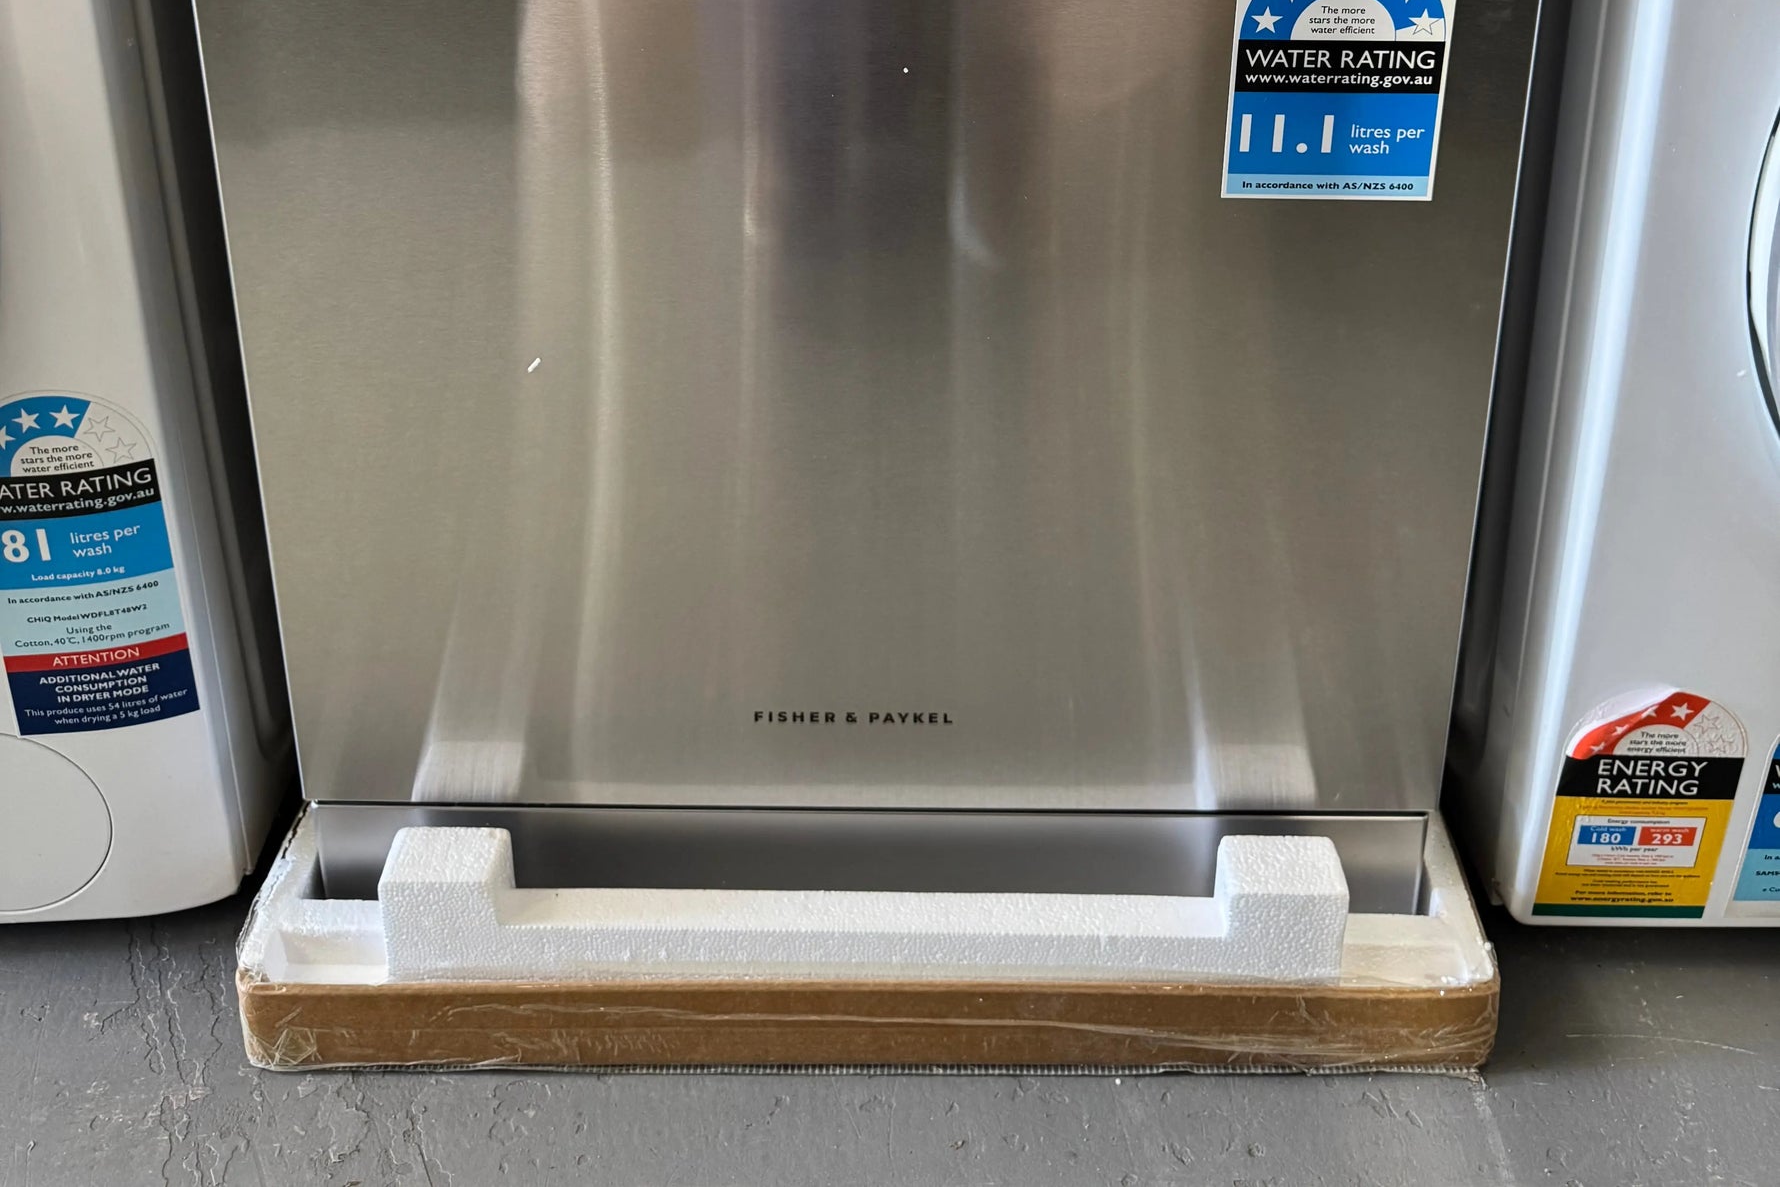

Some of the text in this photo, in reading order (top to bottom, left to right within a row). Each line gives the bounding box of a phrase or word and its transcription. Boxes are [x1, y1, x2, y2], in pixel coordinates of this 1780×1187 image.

[1321, 6, 1338, 14] The
[1334, 16, 1348, 24] the
[1340, 26, 1375, 35] efficient
[1246, 49, 1435, 69] WATER RATING
[1246, 73, 1433, 88] www.waterrating.gov.au
[1239, 114, 1335, 153] 11.1
[1351, 124, 1425, 142] litres per
[1349, 141, 1389, 154] wash
[1242, 181, 1253, 189] In
[1316, 181, 1339, 189] with
[1343, 182, 1386, 191] AS/NZS
[1389, 182, 1413, 191] 6400
[52, 445, 79, 453] more
[21, 452, 92, 464] stars the more
[23, 460, 94, 473] water efficient
[0, 467, 152, 500] ATER RATING
[0, 487, 154, 514] w.waterrating.gov.au
[70, 525, 141, 544] litres per
[73, 543, 112, 558] wash
[31, 566, 125, 581] Load capacity 8.0 kg
[19, 595, 71, 604] accordance
[74, 591, 95, 600] with
[95, 585, 134, 597] AS/NZS
[136, 580, 159, 591] 6400
[54, 612, 80, 622] Model
[15, 638, 53, 648] Cotton,
[82, 632, 125, 644] 1400rpm
[128, 622, 170, 637] program
[66, 624, 112, 635] Using the
[53, 647, 140, 667] ATTENTION
[40, 663, 160, 685] ADDITIONAL WATER
[55, 676, 147, 694] CONSUMPTION
[58, 685, 149, 703] IN DRYER MODE
[24, 689, 188, 717] This produce uses 54 litres of water
[54, 716, 80, 725] when
[81, 715, 111, 724] drying
[127, 709, 139, 718] kg
[140, 705, 161, 716] load
[753, 711, 953, 724] FISHER & PAYKEL
[1598, 759, 1708, 777] ENERGY
[1597, 779, 1700, 795] RATING
[1592, 833, 1683, 844] 180 293
